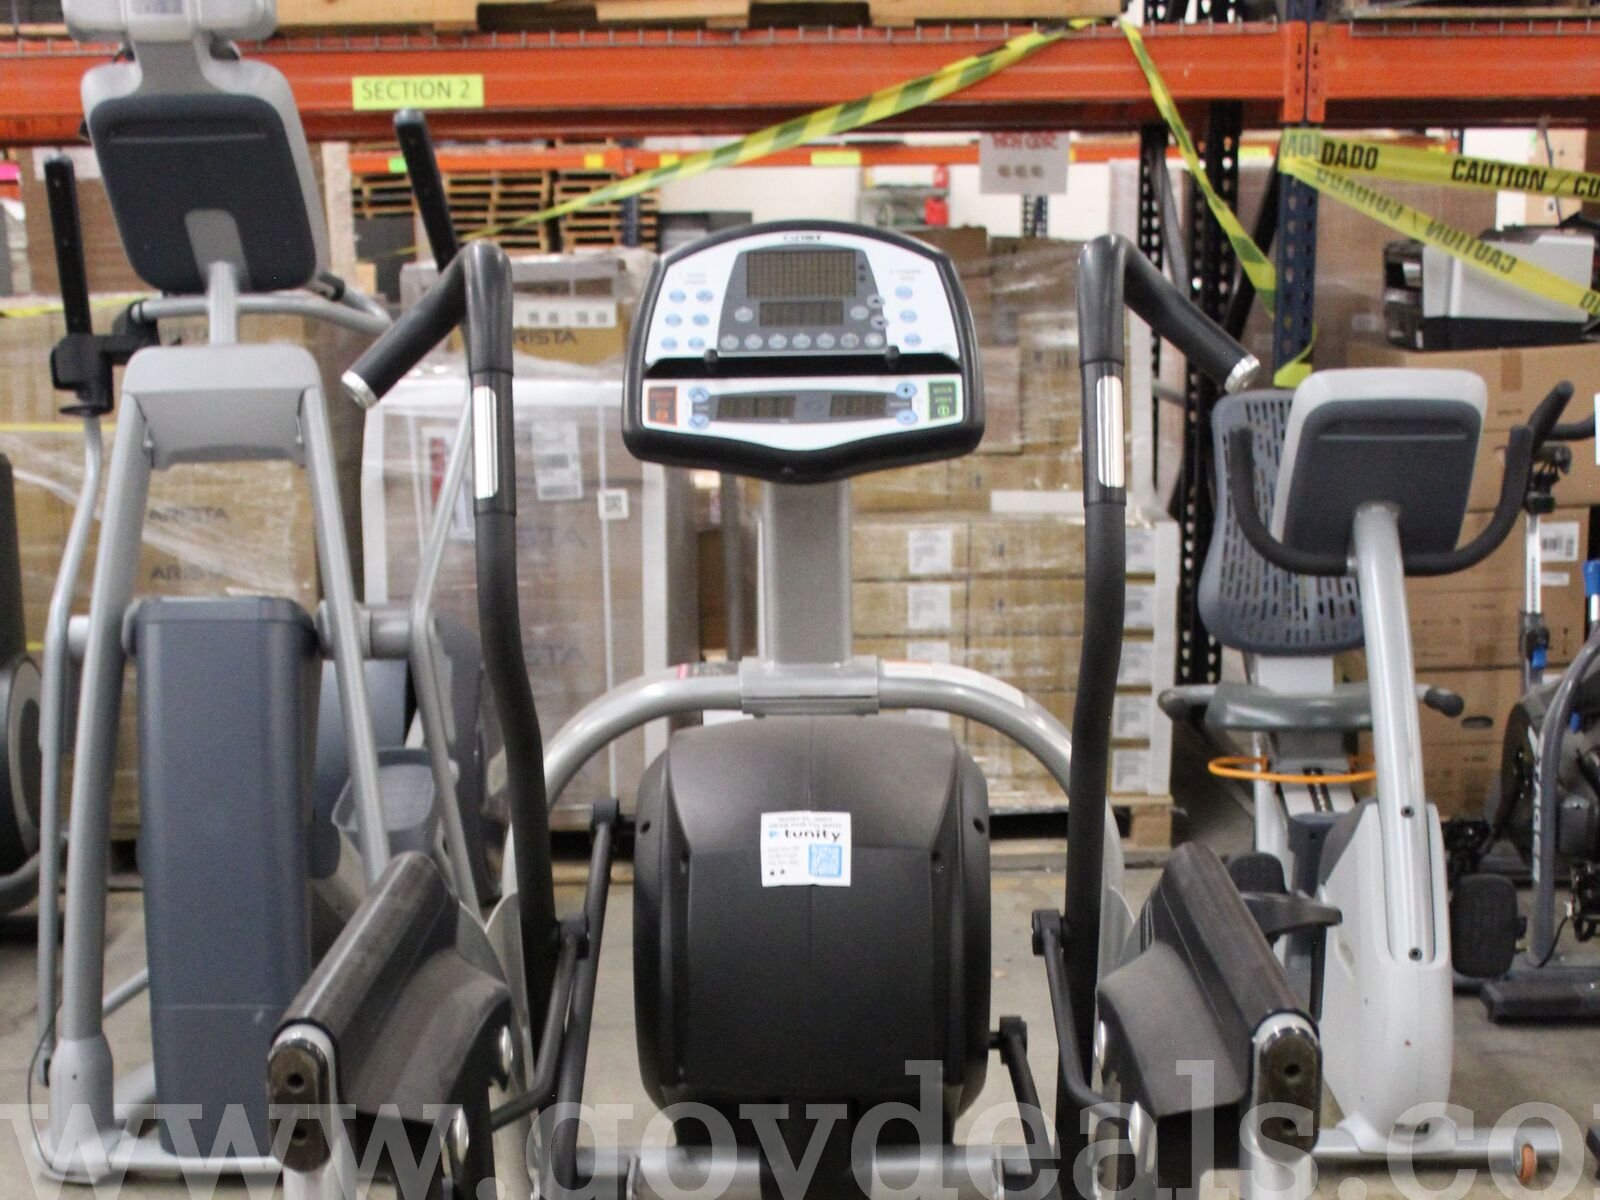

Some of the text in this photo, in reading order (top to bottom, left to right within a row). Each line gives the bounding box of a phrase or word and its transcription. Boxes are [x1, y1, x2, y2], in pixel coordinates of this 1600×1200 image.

[361, 79, 471, 101] SECTION 2
[1451, 158, 1548, 191] CAUTION
[513, 327, 579, 345] RISTA
[785, 829, 840, 843] tunity
